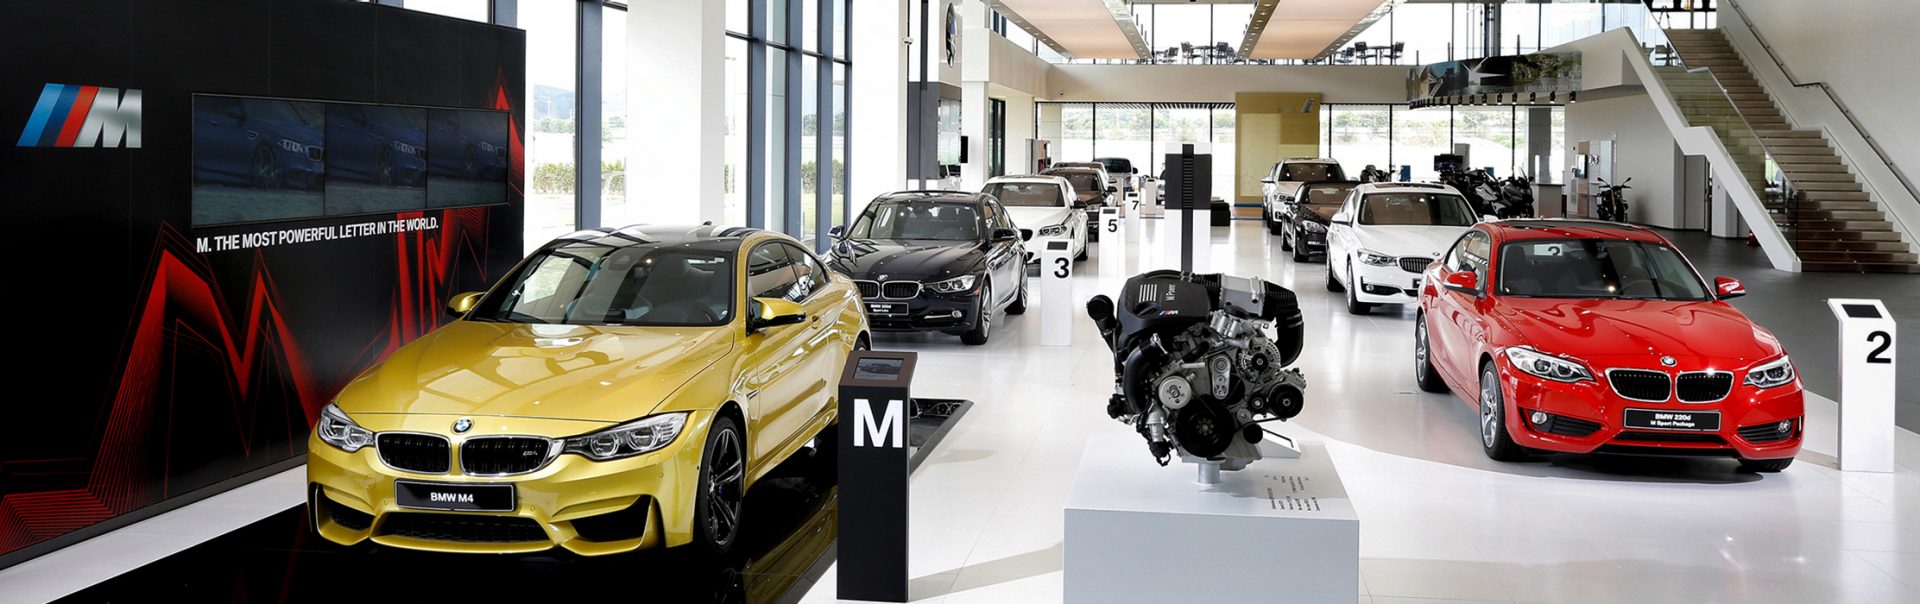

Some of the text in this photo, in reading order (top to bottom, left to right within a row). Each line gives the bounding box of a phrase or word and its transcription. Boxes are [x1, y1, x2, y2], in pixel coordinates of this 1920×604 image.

[1132, 200, 1140, 211] 7
[196, 217, 439, 253] M. THE MOST POWERFUL LETTER IN THE WORLD.
[1108, 219, 1118, 233] 5
[1053, 257, 1070, 279] 3
[1866, 330, 1892, 364] 2
[853, 398, 904, 449] M
[430, 492, 474, 503] BMW M4
